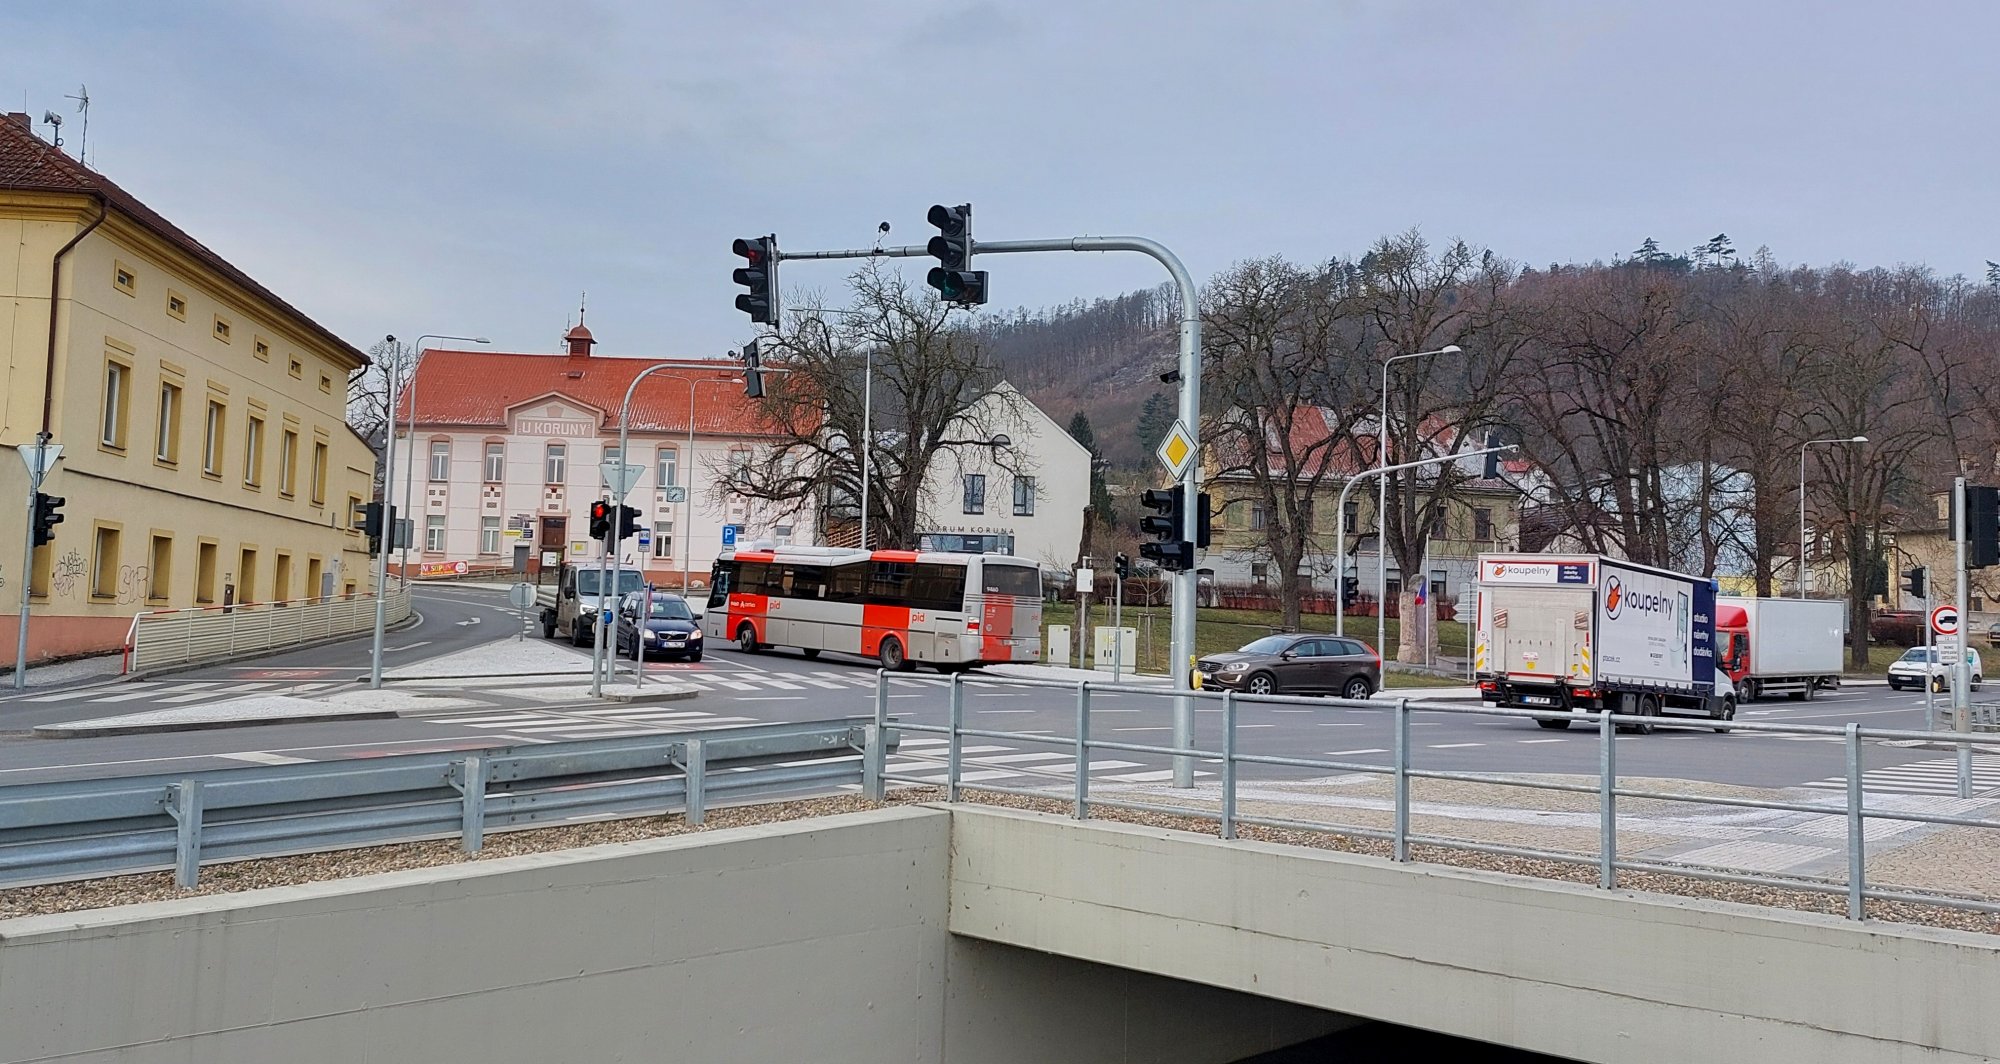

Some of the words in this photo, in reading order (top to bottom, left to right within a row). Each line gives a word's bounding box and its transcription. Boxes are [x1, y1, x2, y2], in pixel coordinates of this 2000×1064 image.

[522, 421, 531, 434] U
[534, 422, 587, 435] KORUNY
[724, 528, 733, 539] P
[970, 526, 1015, 534] KORUNA
[1507, 566, 1551, 576] koupelny
[770, 600, 781, 611] pid
[1624, 584, 1674, 621] koupelny
[911, 612, 925, 623] pid
